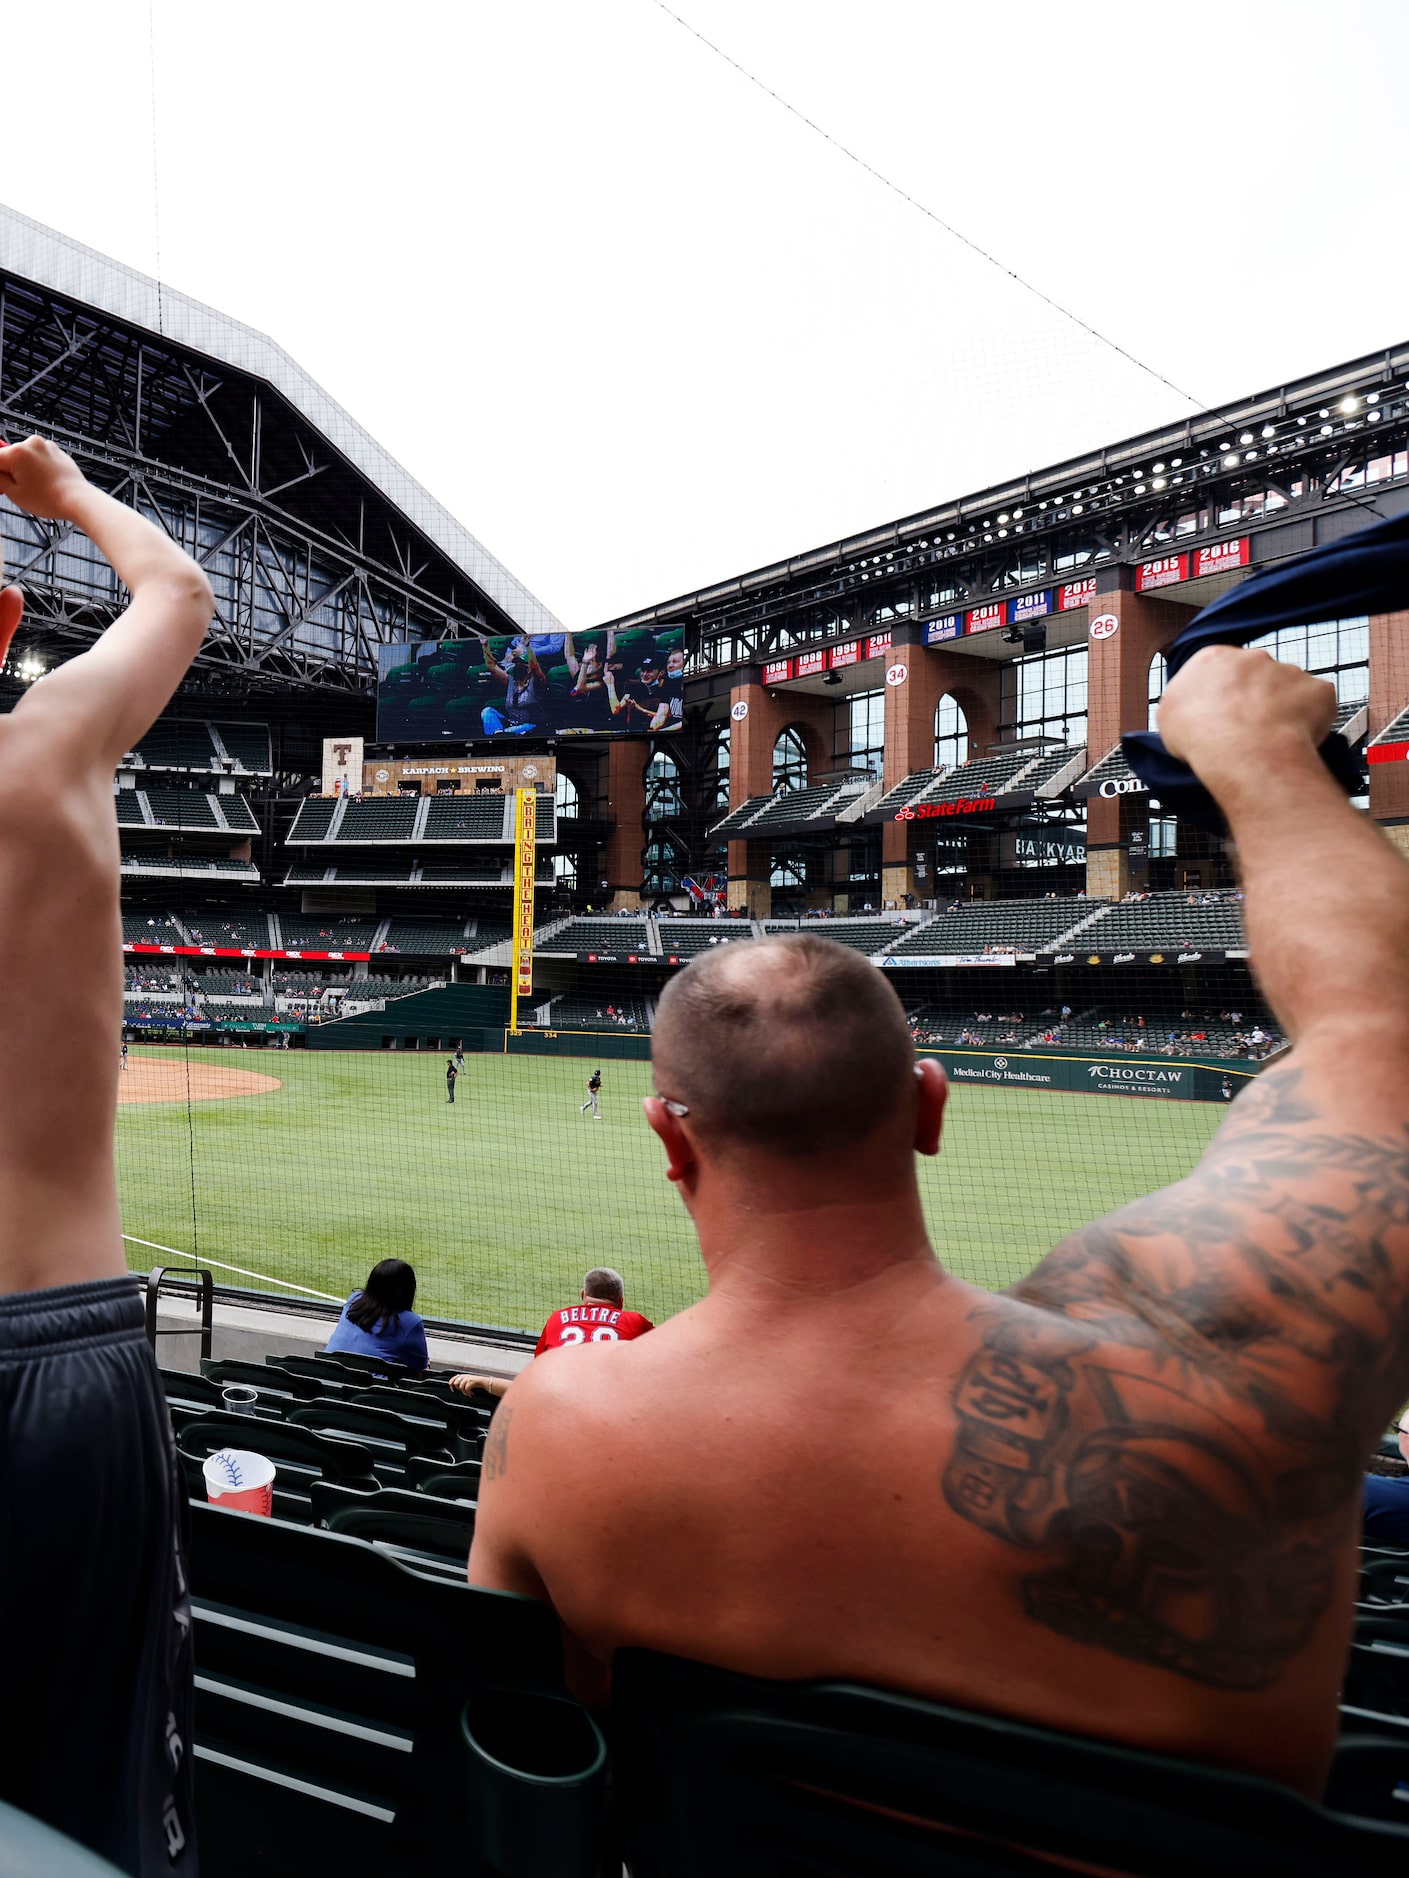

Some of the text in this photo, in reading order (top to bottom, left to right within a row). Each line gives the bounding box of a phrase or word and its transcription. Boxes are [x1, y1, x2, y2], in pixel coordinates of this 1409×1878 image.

[1199, 540, 1240, 561] 2016
[1142, 556, 1179, 576] 2015
[1064, 578, 1096, 597] 2012
[1017, 592, 1045, 609] 2011
[972, 604, 999, 620] 2011
[929, 616, 955, 632] 2010
[1094, 618, 1114, 634] 26
[889, 668, 904, 682] 34
[733, 704, 745, 716] 42
[334, 744, 352, 765] T
[523, 806, 532, 863] BRING
[1016, 839, 1085, 859] BAKYAR
[523, 866, 531, 899] THE
[522, 904, 531, 949] HEAT
[953, 1067, 1051, 1082] Medical City Healthcare
[1097, 1065, 1182, 1082] CHOCTAW
[560, 1306, 621, 1325] BELTRE
